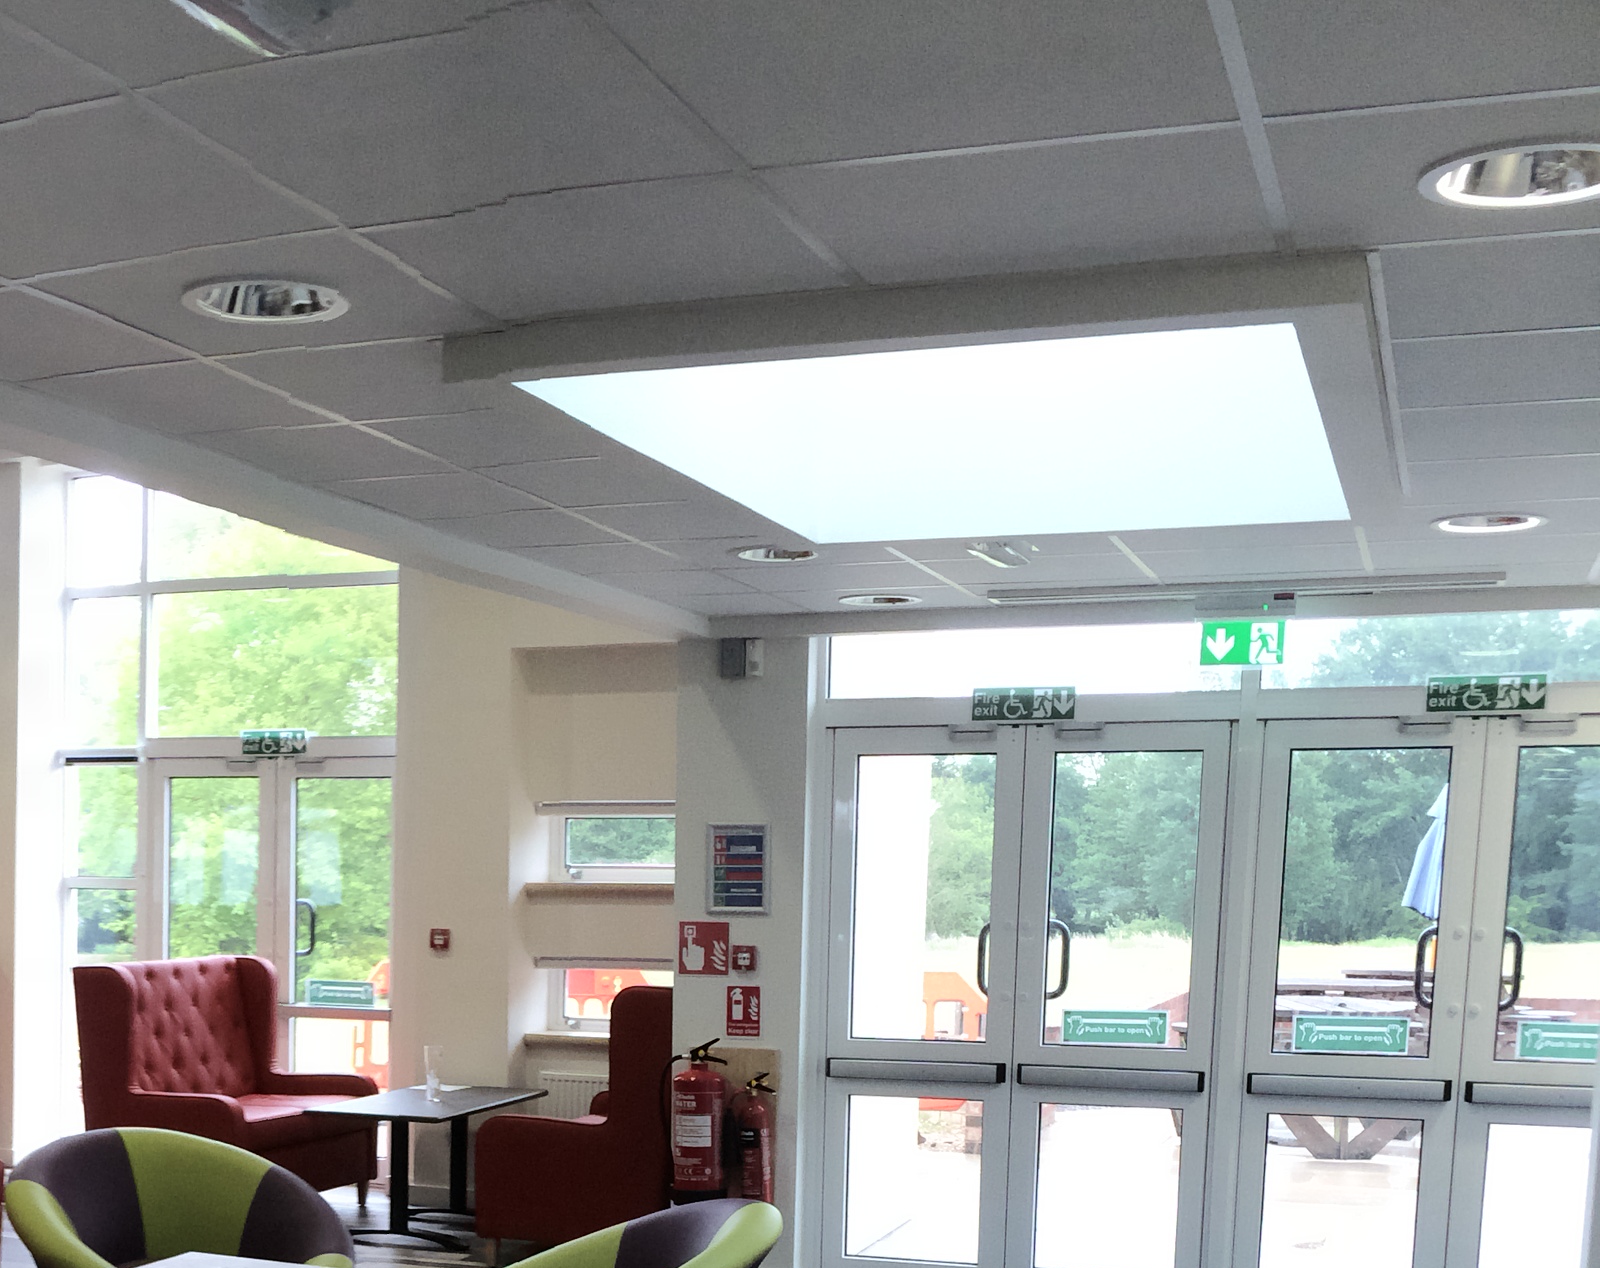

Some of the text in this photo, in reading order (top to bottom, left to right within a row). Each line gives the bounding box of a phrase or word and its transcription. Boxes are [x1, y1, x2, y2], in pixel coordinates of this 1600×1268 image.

[1429, 682, 1459, 694] Fire
[974, 692, 1000, 704] Fire
[1428, 695, 1457, 708] exit
[974, 704, 998, 716] exit
[1085, 1026, 1102, 1034] Push
[1104, 1026, 1116, 1034] bar
[1318, 1033, 1337, 1041] Push
[1363, 1035, 1383, 1043] open
